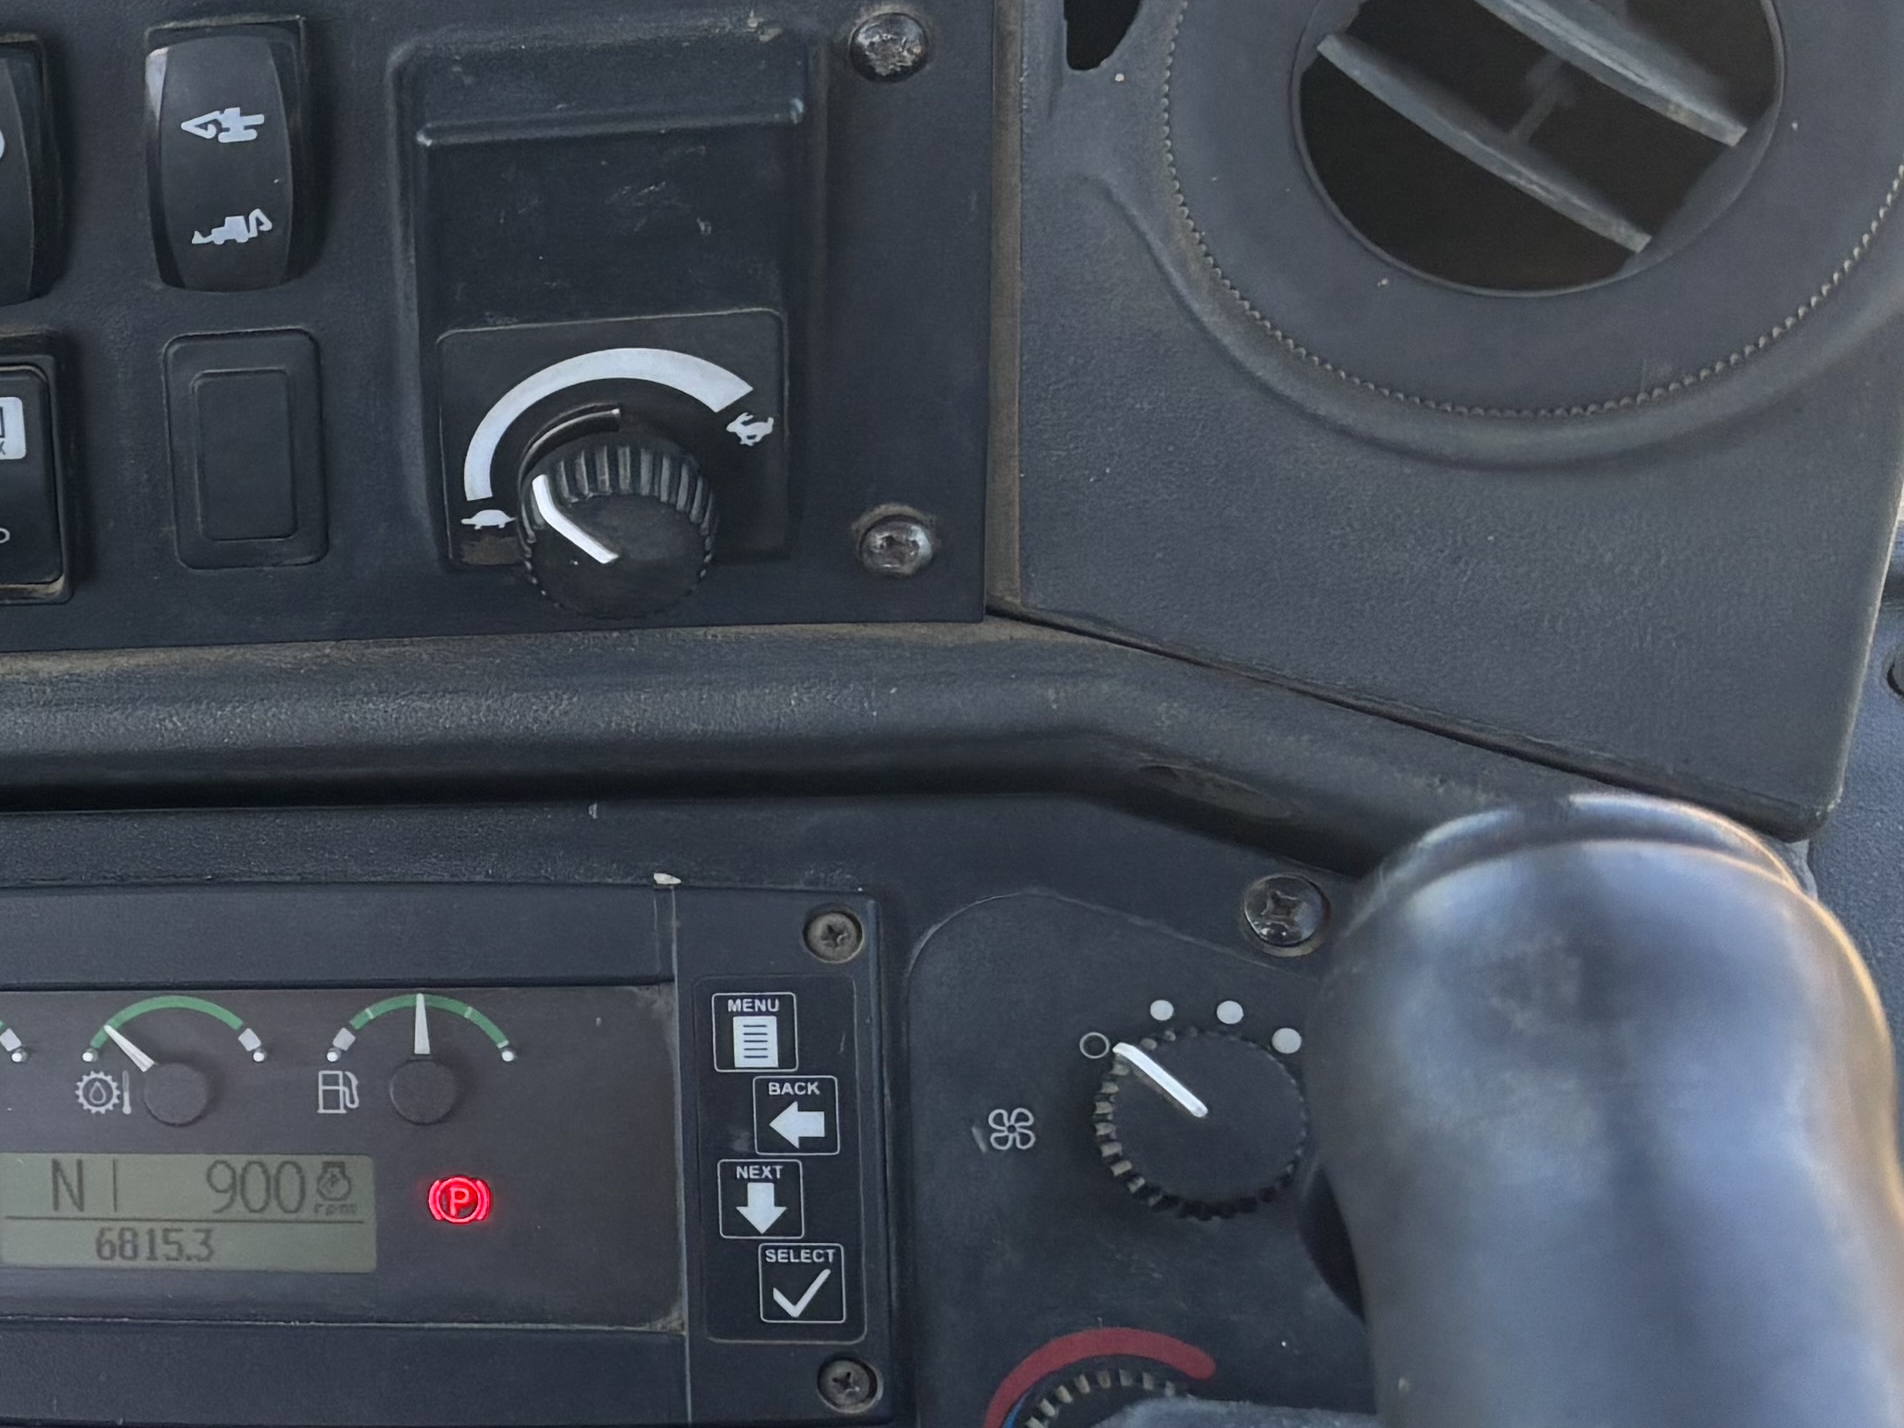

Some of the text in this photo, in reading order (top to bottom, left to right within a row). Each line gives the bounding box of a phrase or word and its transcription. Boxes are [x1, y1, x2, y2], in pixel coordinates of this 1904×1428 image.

[728, 998, 780, 1012] MENU
[768, 1081, 821, 1096] BACK
[736, 1165, 783, 1179] NEXT
[51, 1158, 85, 1213] N
[206, 1160, 306, 1215] 900
[95, 1227, 215, 1262] 6815.3
[765, 1248, 836, 1263] SELECT
